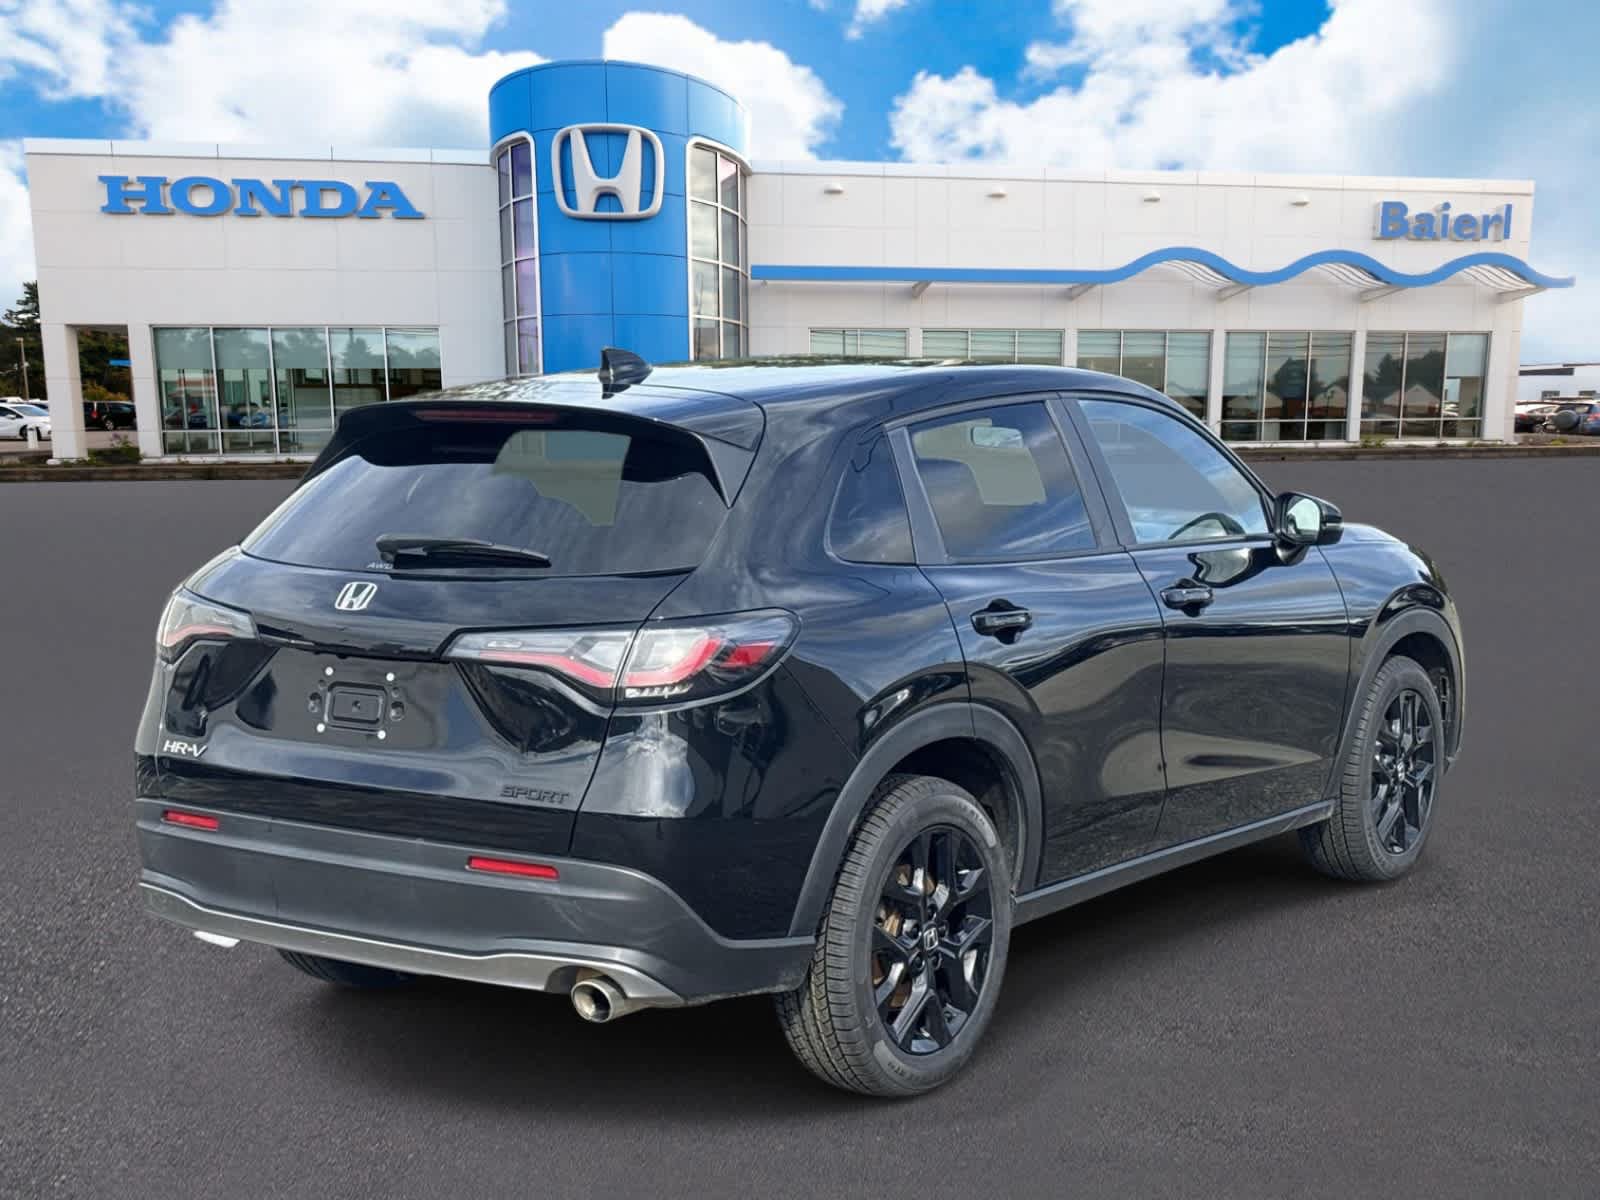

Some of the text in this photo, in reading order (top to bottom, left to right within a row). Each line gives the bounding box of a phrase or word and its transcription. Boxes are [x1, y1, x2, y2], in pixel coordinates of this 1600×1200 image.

[98, 175, 425, 219] HONDA
[1378, 200, 1513, 240] Baierl
[163, 740, 207, 758] HR-V
[500, 785, 570, 804] SPORT
